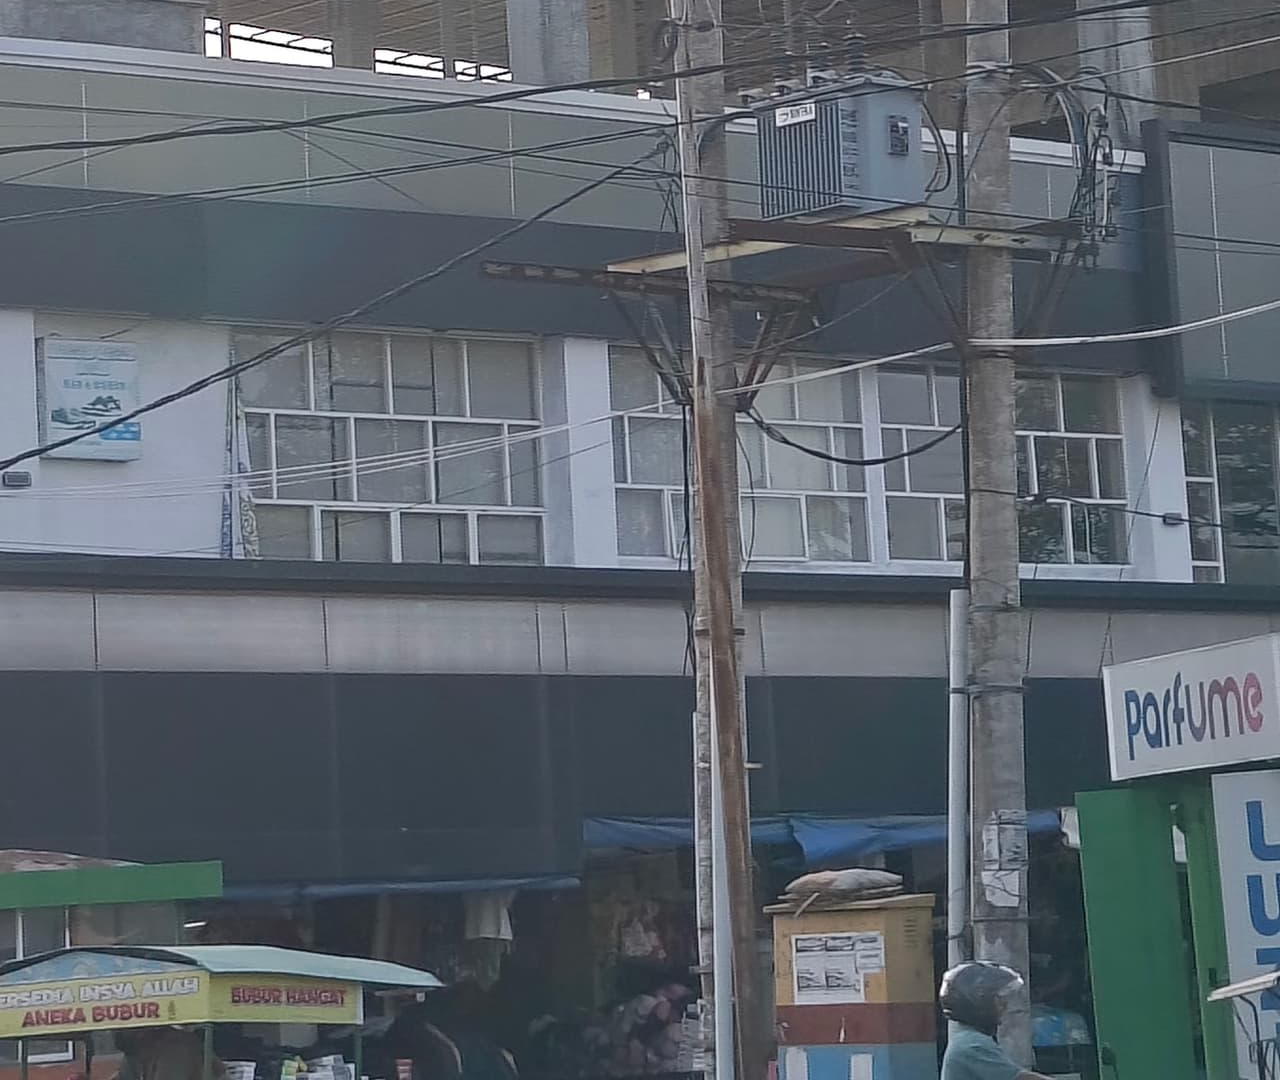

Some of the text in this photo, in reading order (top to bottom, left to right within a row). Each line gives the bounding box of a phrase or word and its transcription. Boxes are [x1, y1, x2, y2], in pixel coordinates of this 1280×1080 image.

[80, 983, 136, 1002] INSYA
[142, 977, 200, 997] ALLAH
[231, 986, 347, 1006] BUBUR HANGAT
[22, 1002, 160, 1028] ANEKA BUBUR
